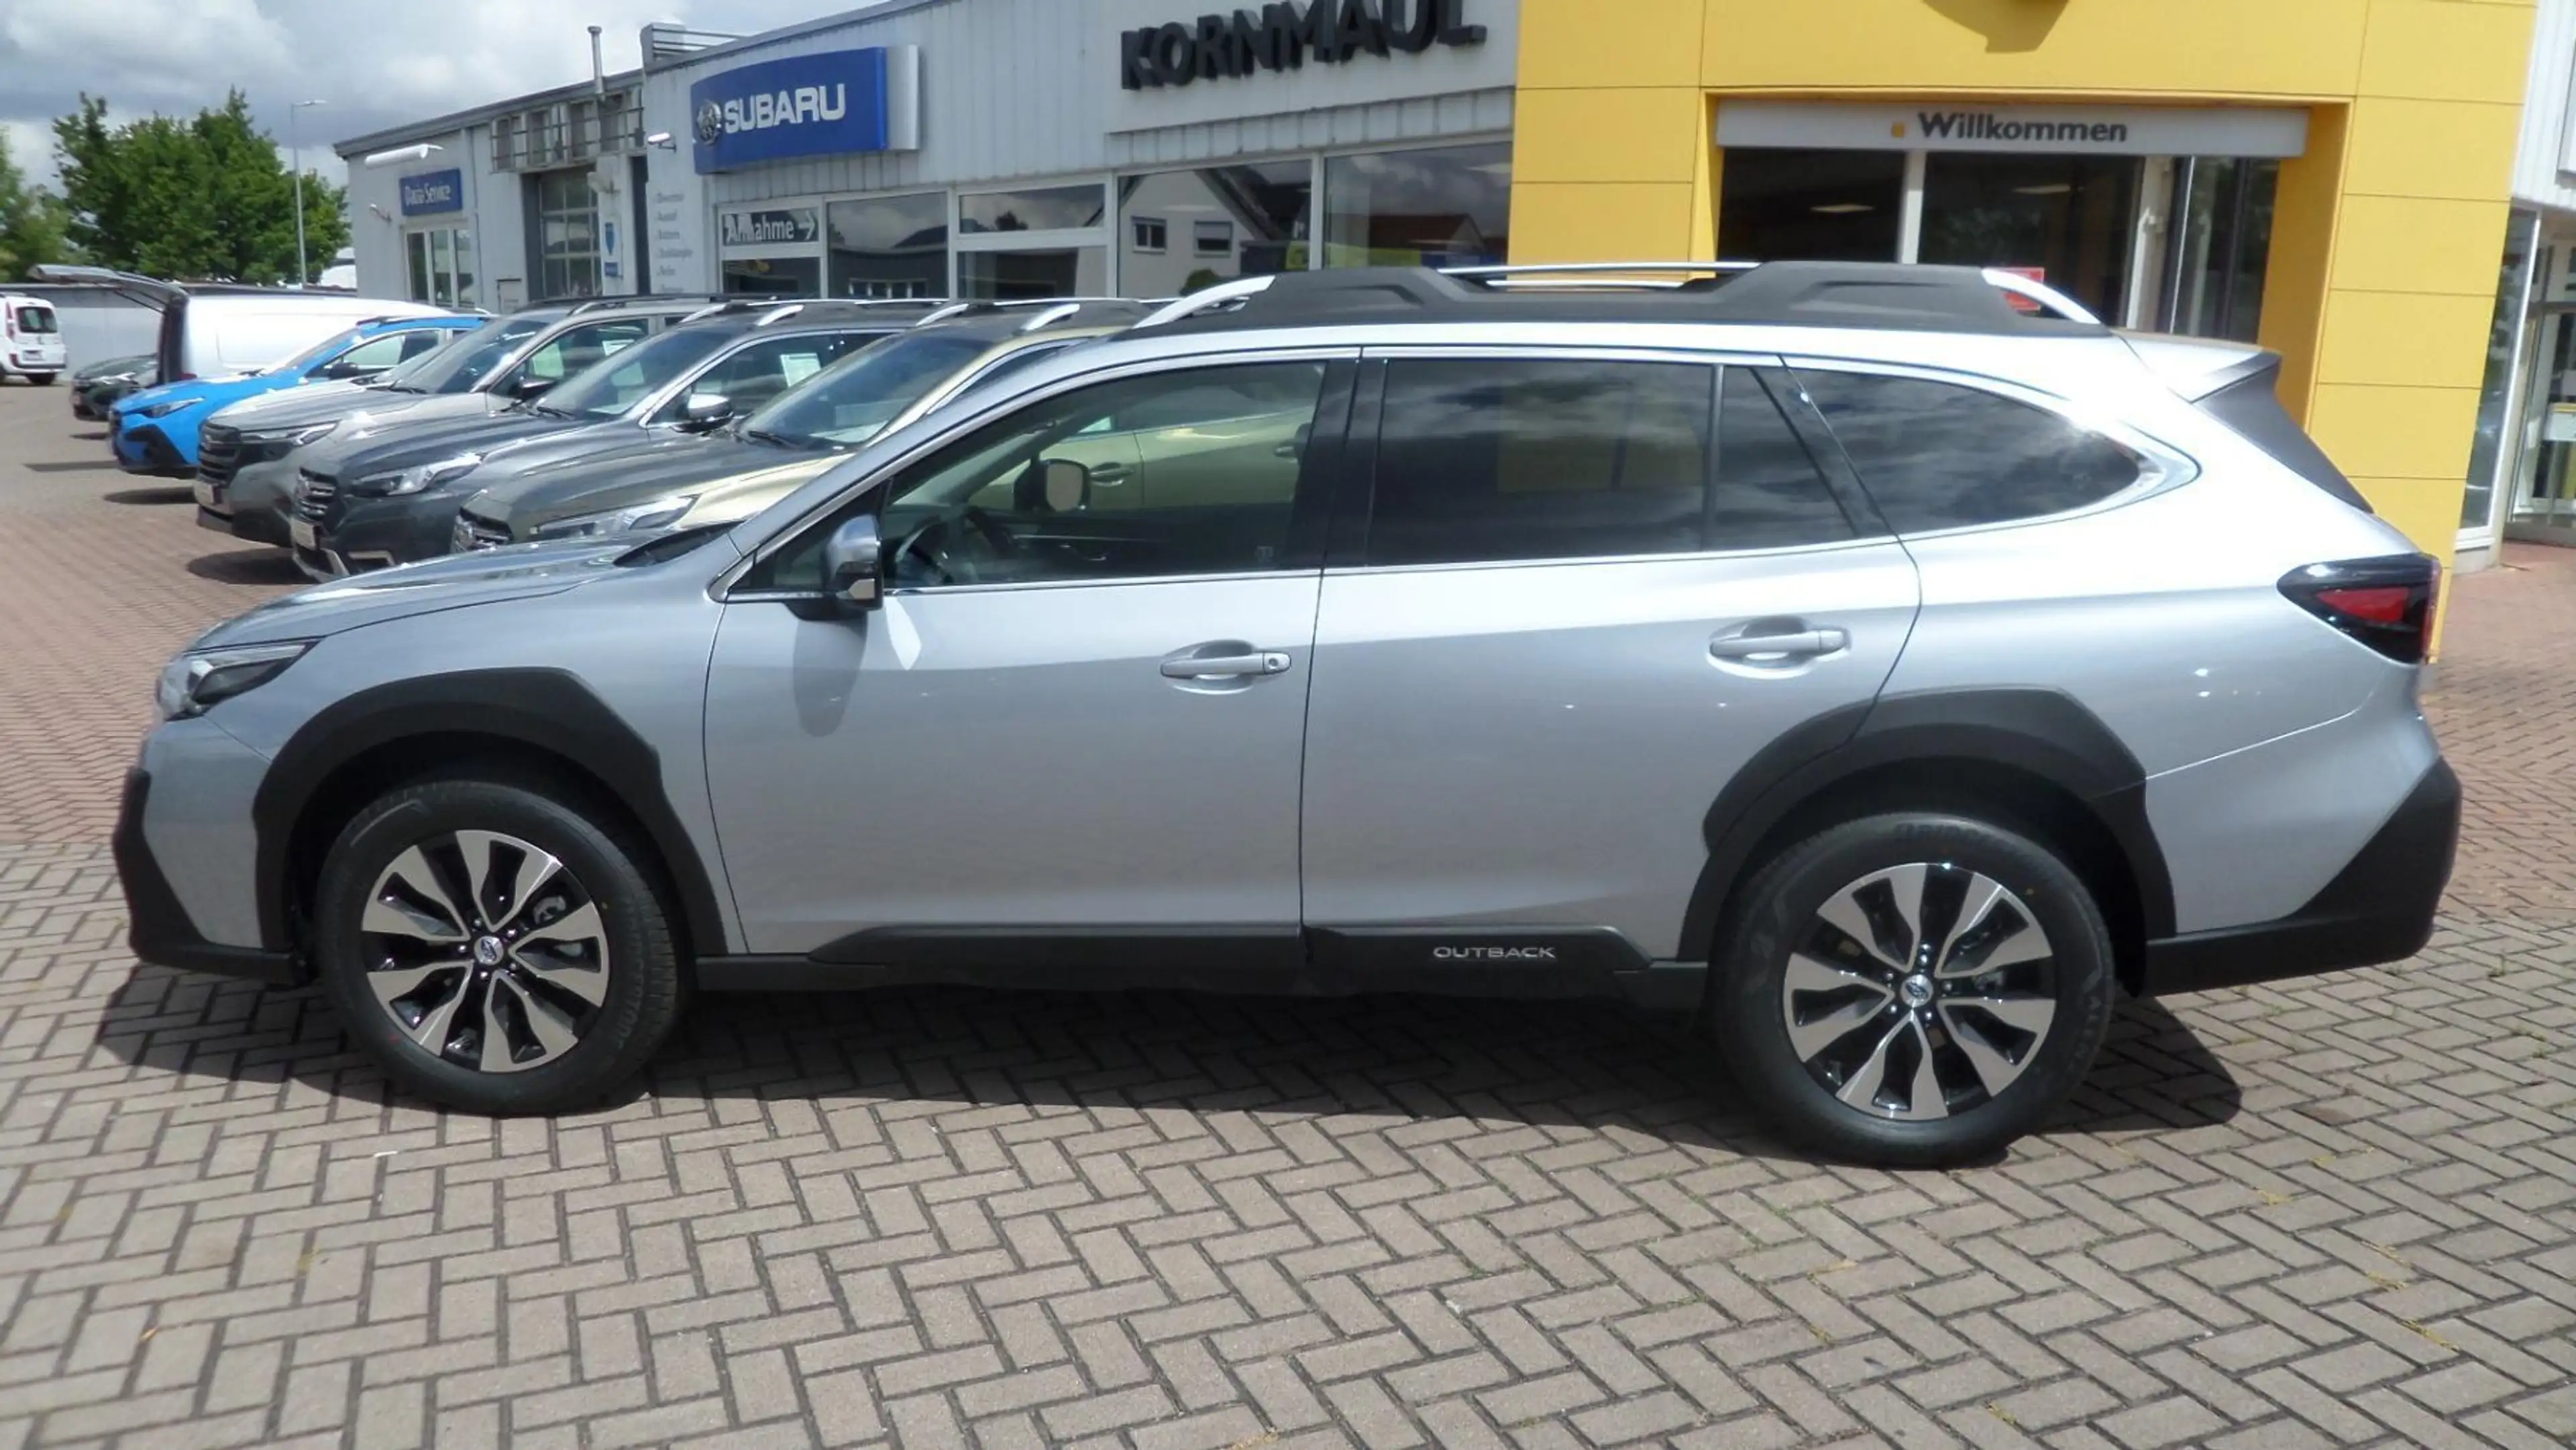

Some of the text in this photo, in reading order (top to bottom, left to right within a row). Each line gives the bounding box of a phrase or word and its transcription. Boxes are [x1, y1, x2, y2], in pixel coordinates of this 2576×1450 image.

[1122, 0, 1487, 89] KORNMAUL
[724, 83, 846, 135] SUBARU
[1918, 113, 2127, 142] Willkommen
[1433, 946, 1556, 958] OUTBACK
